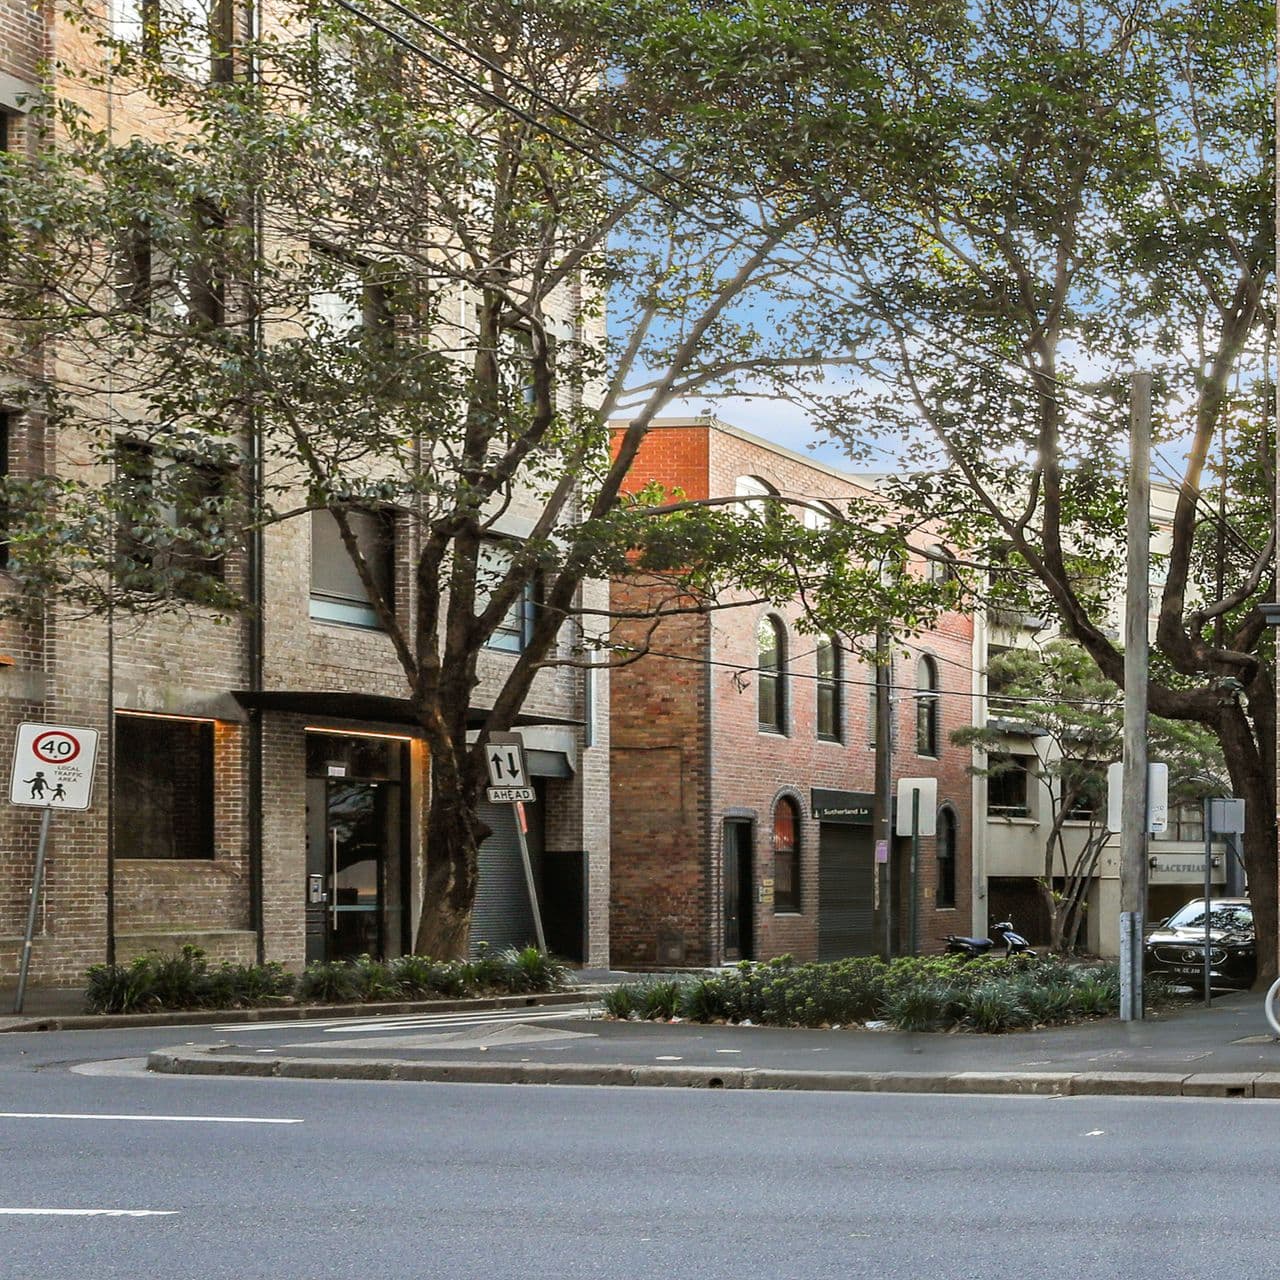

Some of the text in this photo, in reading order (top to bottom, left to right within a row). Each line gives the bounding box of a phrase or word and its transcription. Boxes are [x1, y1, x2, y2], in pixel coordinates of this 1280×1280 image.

[40, 740, 71, 755] 40
[54, 770, 83, 778] TRAFFIC
[493, 790, 530, 800] AHEAD
[823, 808, 858, 816] Sutherland
[1154, 864, 1210, 873] BLACKFRIAR
